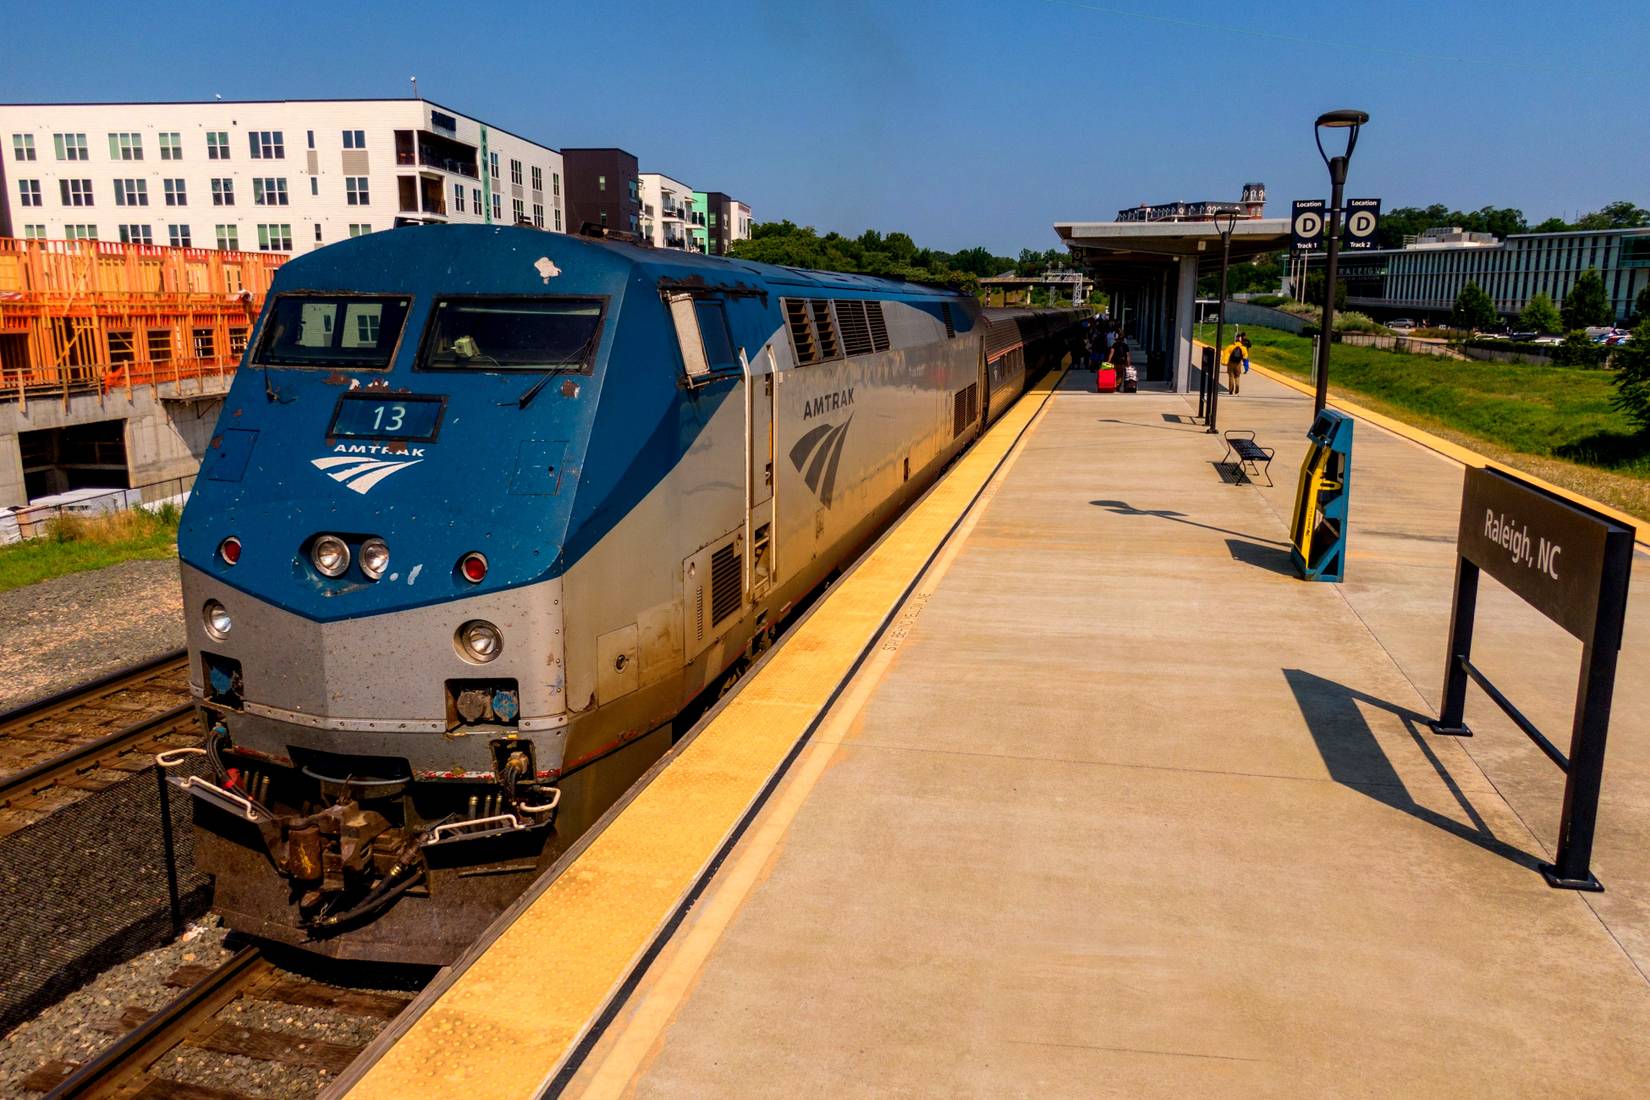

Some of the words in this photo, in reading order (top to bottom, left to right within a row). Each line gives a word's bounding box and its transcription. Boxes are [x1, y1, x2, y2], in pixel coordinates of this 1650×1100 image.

[1303, 218, 1316, 232] D
[1356, 216, 1370, 231] D
[803, 387, 855, 420] AMTRAK
[373, 406, 406, 431] 13
[1484, 508, 1533, 569] Raleigh,
[1537, 537, 1561, 580] NC
